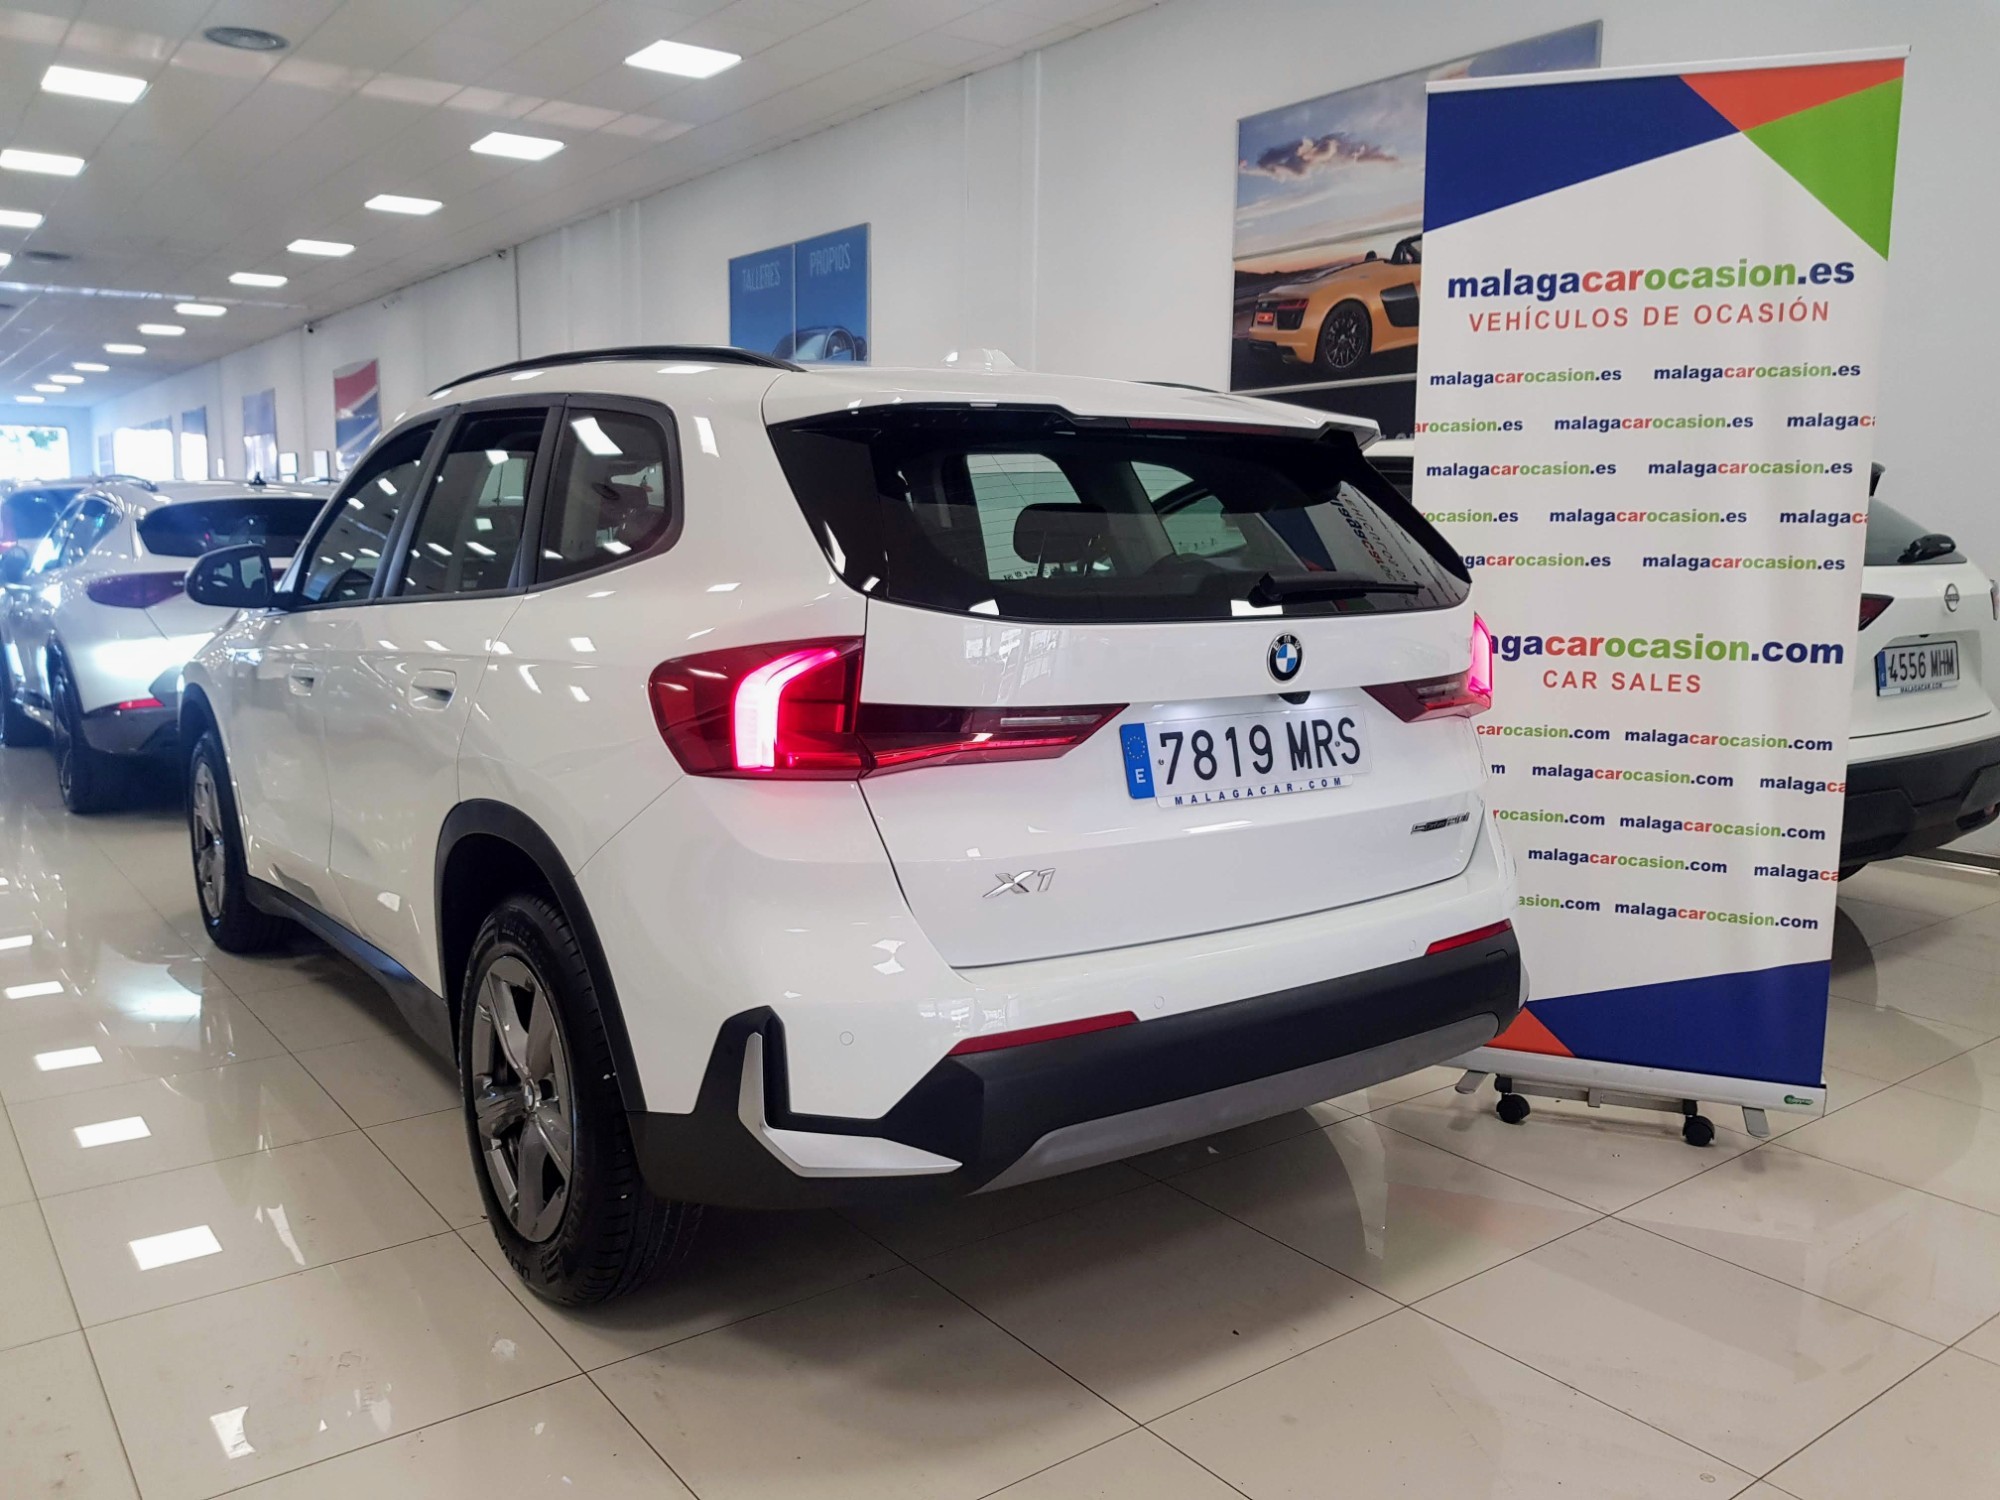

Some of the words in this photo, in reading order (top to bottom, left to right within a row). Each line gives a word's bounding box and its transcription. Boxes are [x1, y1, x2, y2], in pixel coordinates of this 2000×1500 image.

[742, 261, 781, 293] TALLERES
[809, 242, 851, 278] PROPIOS
[1447, 258, 1855, 302] malagacarocasion.es
[1468, 306, 1629, 333] VEHÍCULOS
[1643, 304, 1679, 327] DE
[1693, 296, 1830, 326] OCASIÓN
[1429, 367, 1622, 388] malagacarocasion.es
[1653, 361, 1861, 382] malagacarocasion.es
[1554, 412, 1754, 433] malagacarocasion.es
[1426, 461, 1617, 480] malagacarocasion.es
[1648, 459, 1853, 478] malagacarocasion.es
[1549, 507, 1748, 526] malagacarocasion.es
[1461, 553, 1612, 569] gacarocasion.es
[1642, 553, 1846, 572] malagacarocasion.es
[1273, 635, 1301, 650] BMW
[1888, 652, 1926, 682] 4556
[1930, 648, 1954, 678] MHM
[1542, 669, 1598, 690] CAR
[1611, 671, 1701, 694] SALES
[1159, 724, 1274, 785] 7819
[1285, 716, 1361, 772] MRS
[1625, 728, 1833, 751] malagacarocasion.com
[1135, 768, 1147, 784] E
[1532, 764, 1734, 787] malagacarocasion.com
[1174, 776, 1342, 806] MALAGACAR.COM
[1620, 815, 1826, 840] malagacarocasion.com
[1528, 848, 1728, 874] malagacarocasion.com
[982, 867, 1057, 898] X1
[1615, 902, 1818, 930] malagacarocasion.com
